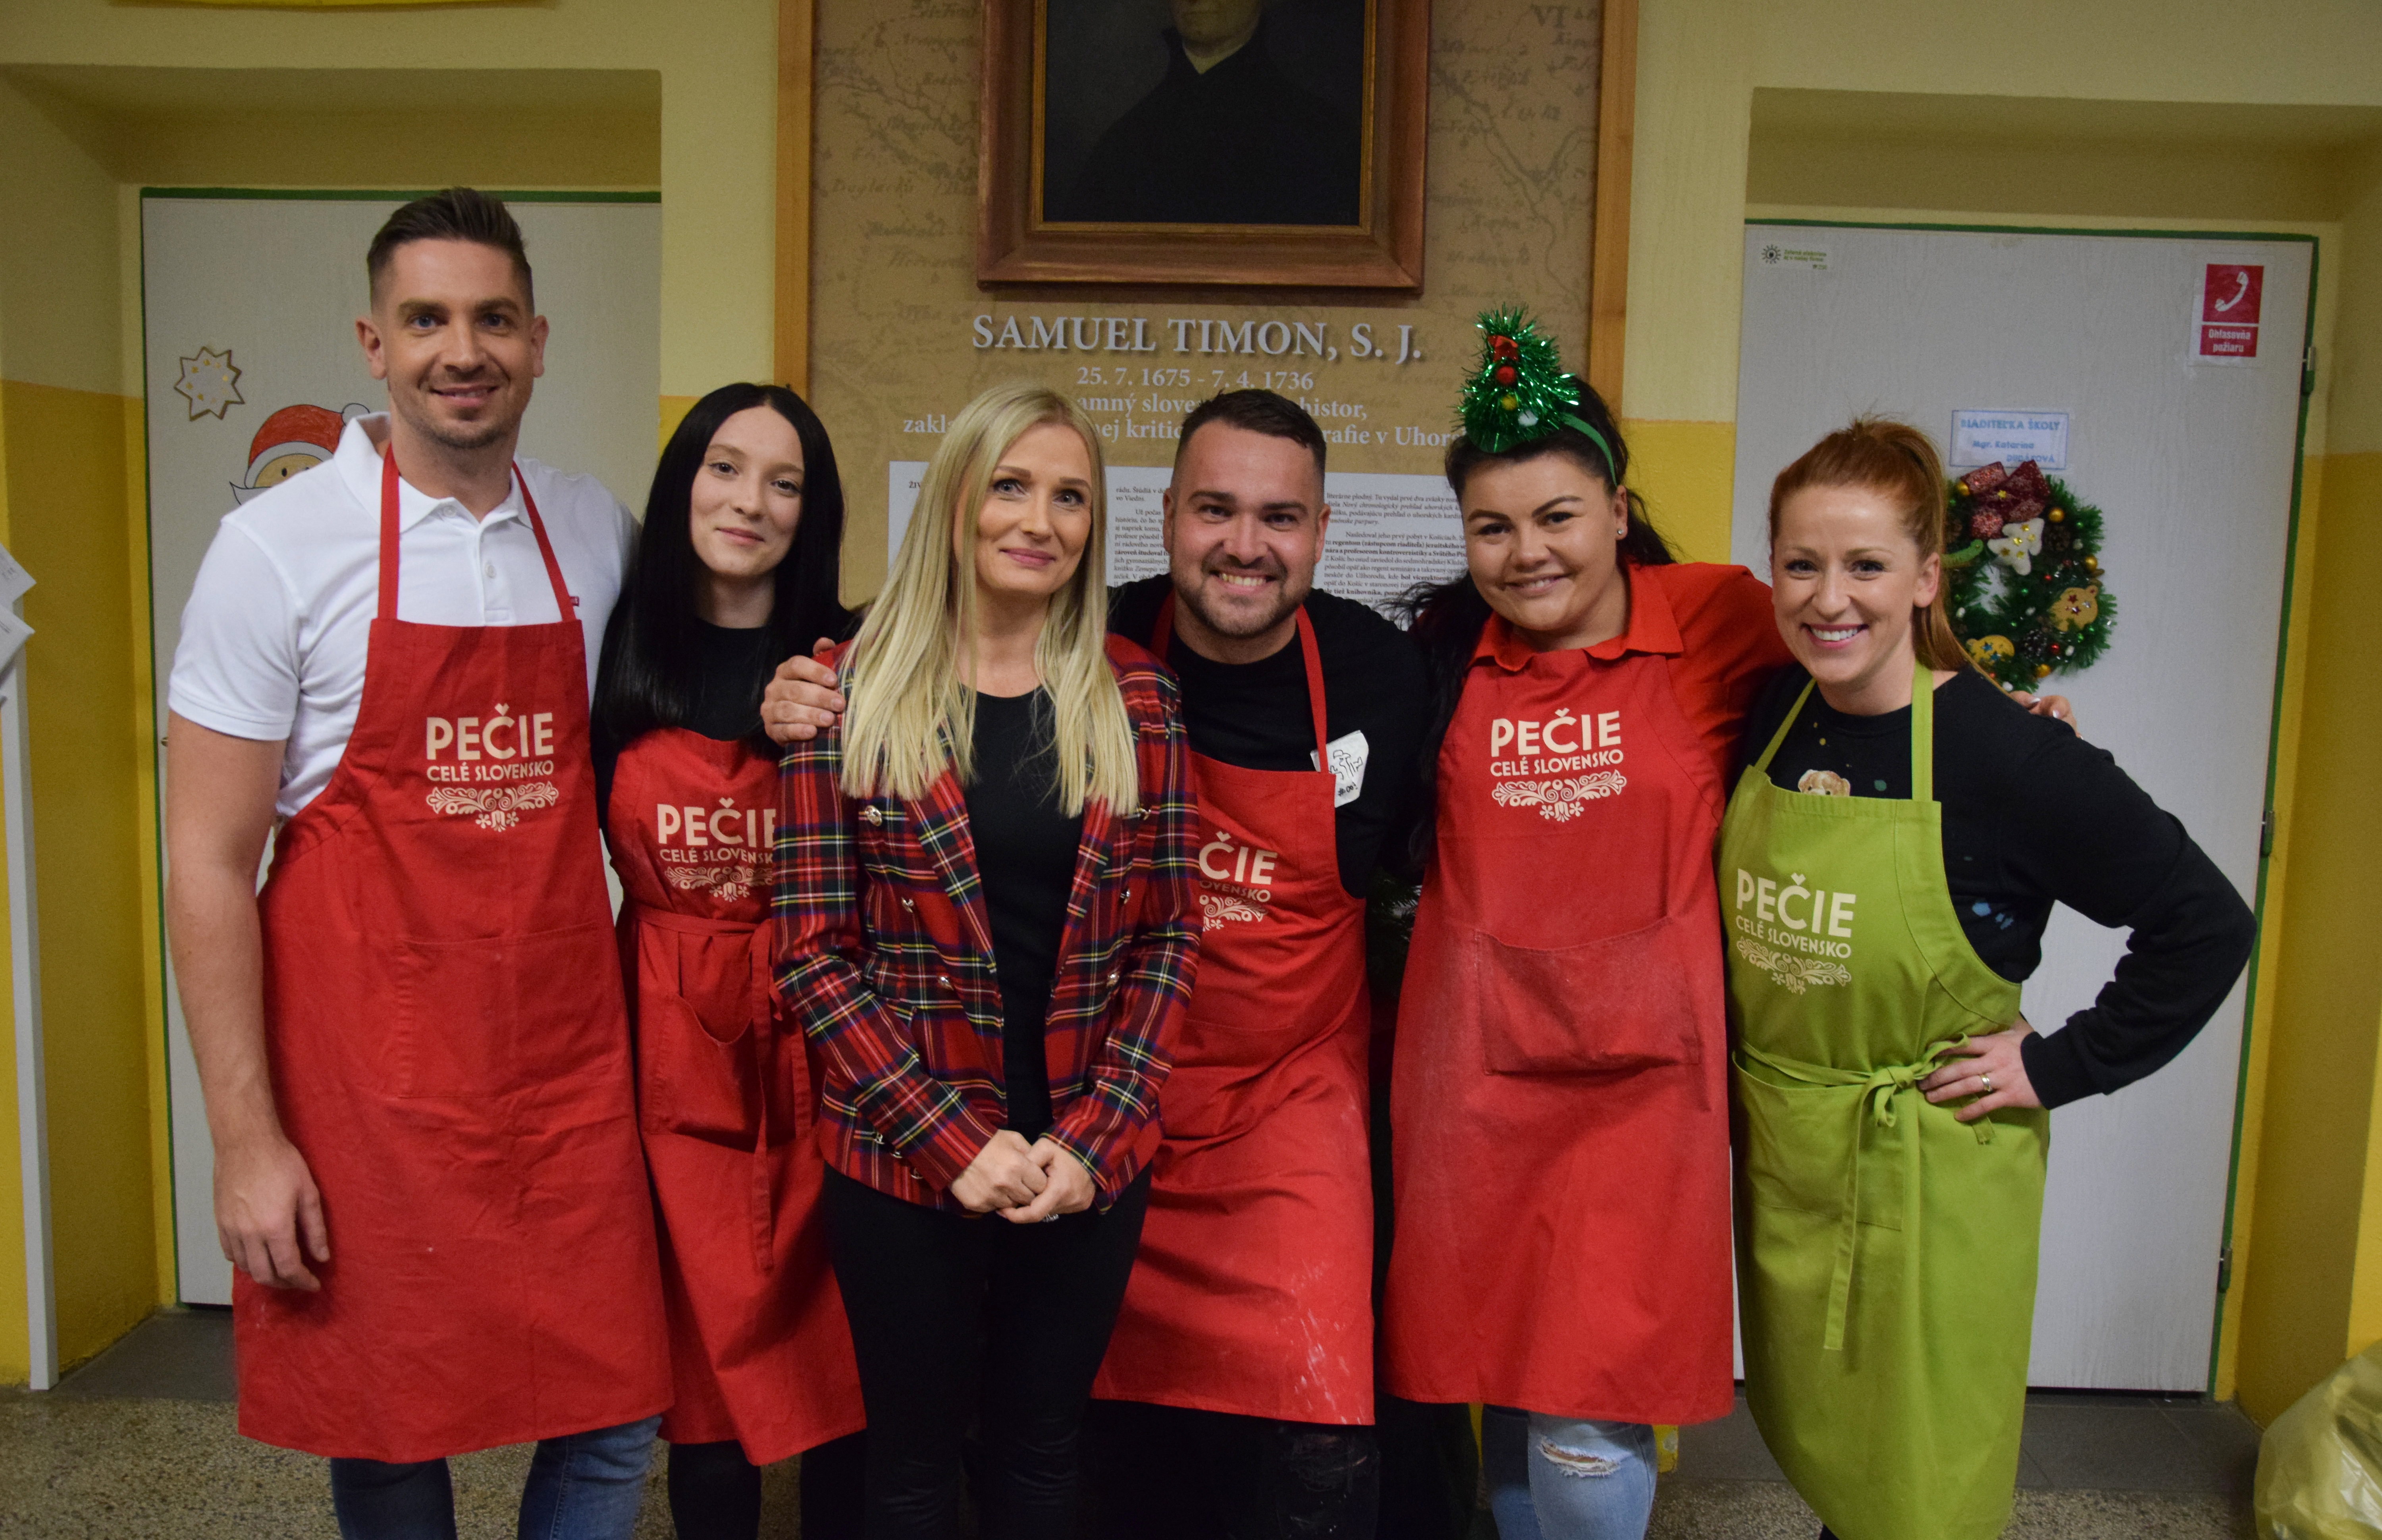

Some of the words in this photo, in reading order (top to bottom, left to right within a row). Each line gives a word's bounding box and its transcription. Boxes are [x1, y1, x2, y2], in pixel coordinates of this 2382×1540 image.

[972, 315, 1156, 351] SAMUEL
[1167, 318, 1337, 361] TIMON,
[1351, 323, 1383, 357] S.
[1396, 325, 1421, 365] J.
[2209, 329, 2251, 340] Ohlasovňa
[2213, 342, 2244, 352] požiaru
[1077, 367, 1108, 385] 25.
[1115, 368, 1133, 386] 7.
[1142, 368, 1190, 387] 1675
[1212, 370, 1230, 388] 7.
[1237, 370, 1255, 389] 4.
[1264, 372, 1314, 390] 1736
[1077, 393, 1137, 418] amný
[1142, 393, 1200, 413] slove
[1299, 397, 1367, 421] histor,
[1126, 419, 1183, 439] kritic
[1322, 424, 1370, 445] rafie
[1375, 431, 1388, 444] v
[1395, 426, 1468, 447] Uhor
[2027, 418, 2060, 430] ŠKOLY
[1972, 440, 1992, 449] Mgr.
[1379, 549, 1428, 557] kontroverzistiky
[426, 703, 554, 760] PEČIE
[1491, 708, 1621, 757] PEČIE
[427, 762, 470, 782] CELÉ
[475, 760, 554, 781] SLOVENSKO
[1490, 756, 1529, 777] CELÉ
[1534, 749, 1623, 774] SLOVENSKO
[660, 847, 698, 863] CELÉ
[703, 847, 773, 864] SLOVENSK
[1199, 831, 1278, 885] ČIE
[1199, 880, 1271, 902] OVENSKO
[1736, 868, 1856, 938] PEČIE
[1736, 915, 1764, 939] CELÉ
[1768, 928, 1852, 959] SLOVENSKO
